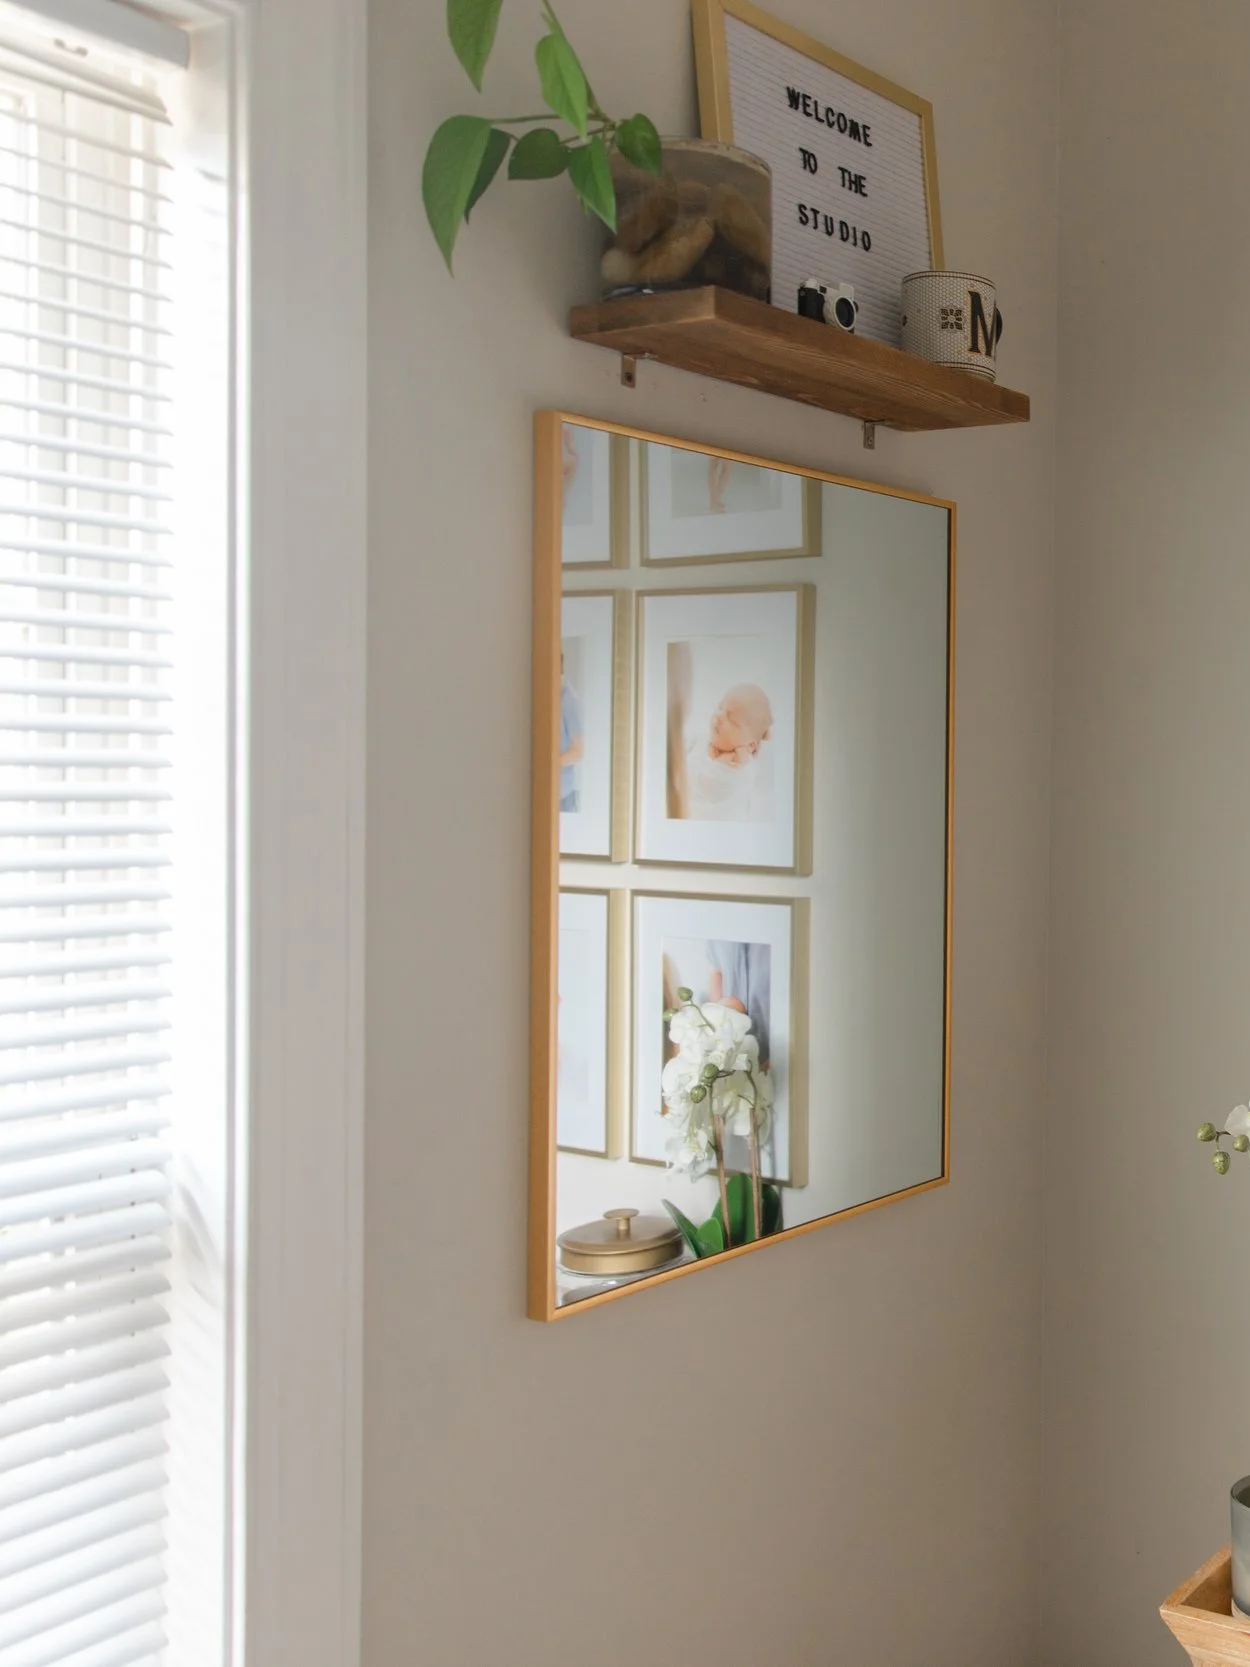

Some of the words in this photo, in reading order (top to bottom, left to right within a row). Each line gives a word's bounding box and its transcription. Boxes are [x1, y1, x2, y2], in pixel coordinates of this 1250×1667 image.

[786, 86, 873, 147] WELCOME
[799, 147, 818, 174] TO
[838, 166, 868, 197] THE
[798, 203, 872, 252] STUDIO
[967, 290, 996, 359] M
